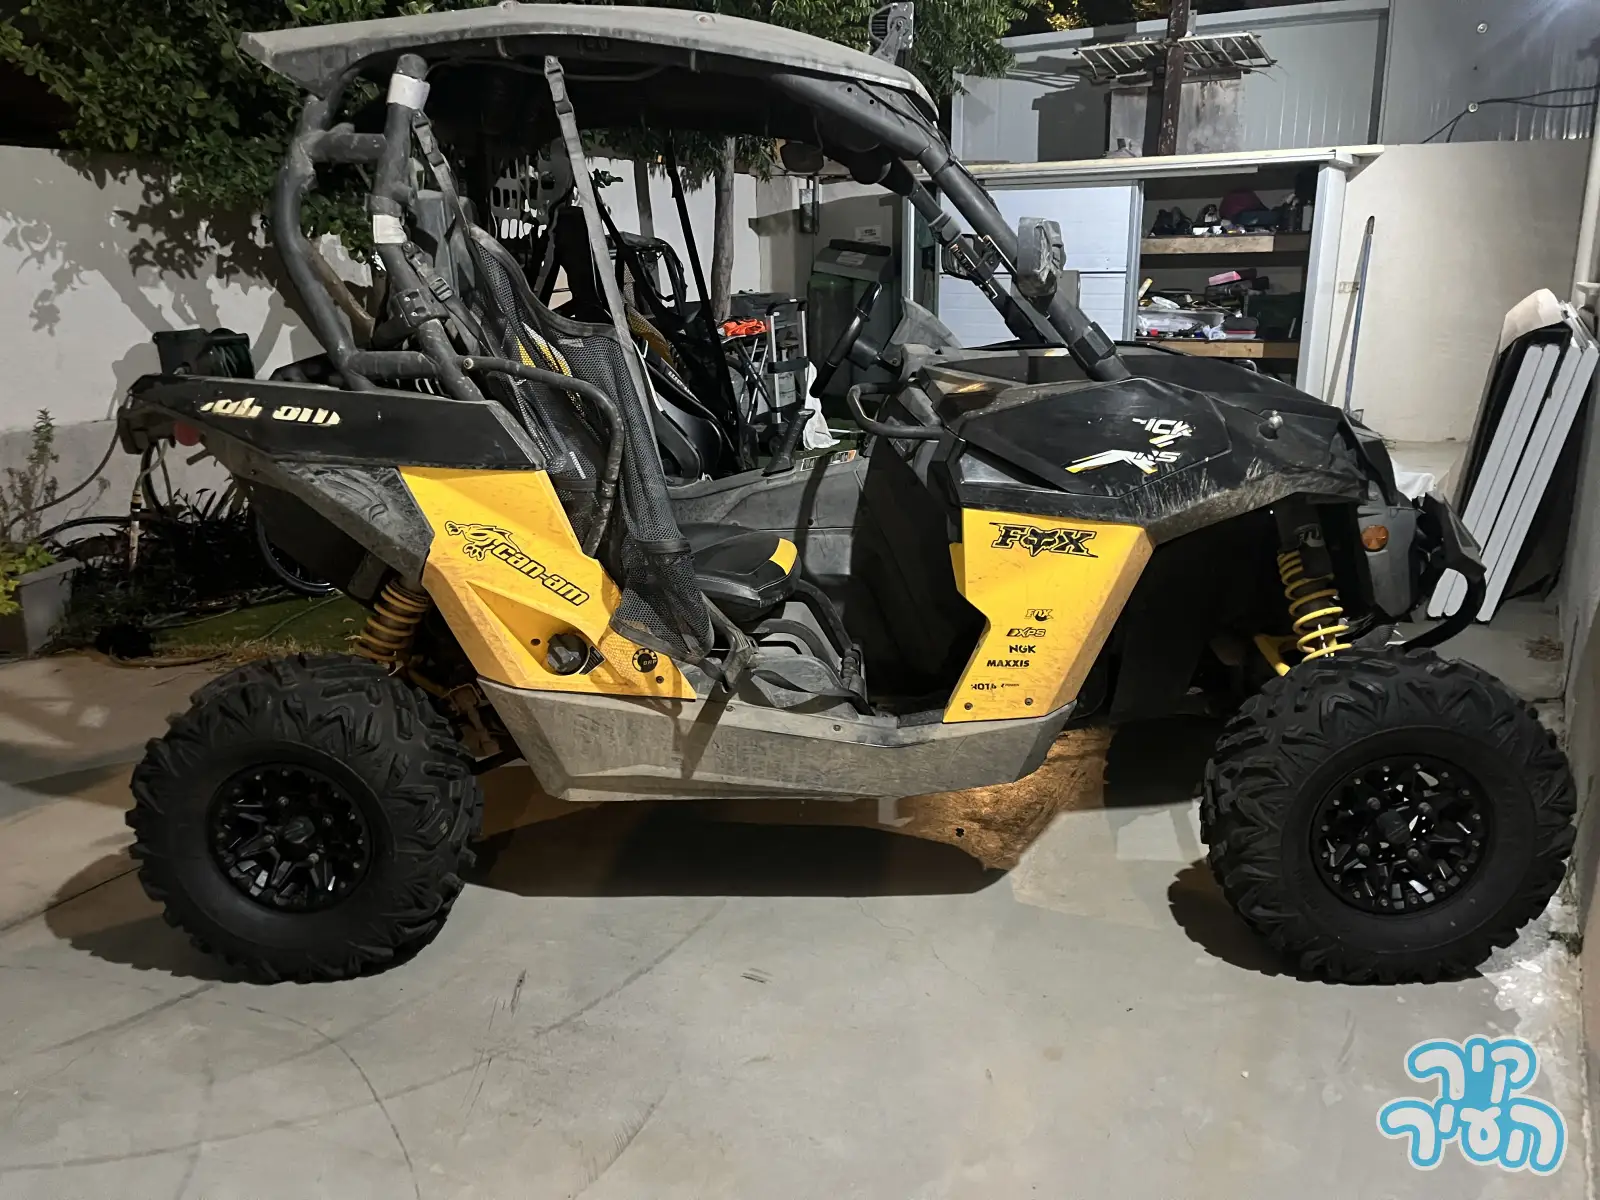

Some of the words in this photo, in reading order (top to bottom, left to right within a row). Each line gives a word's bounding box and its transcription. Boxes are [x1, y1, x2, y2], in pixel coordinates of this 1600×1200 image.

[490, 542, 590, 606] can-am
[1008, 644, 1037, 654] NGK
[986, 659, 1030, 668] MAXXIS
